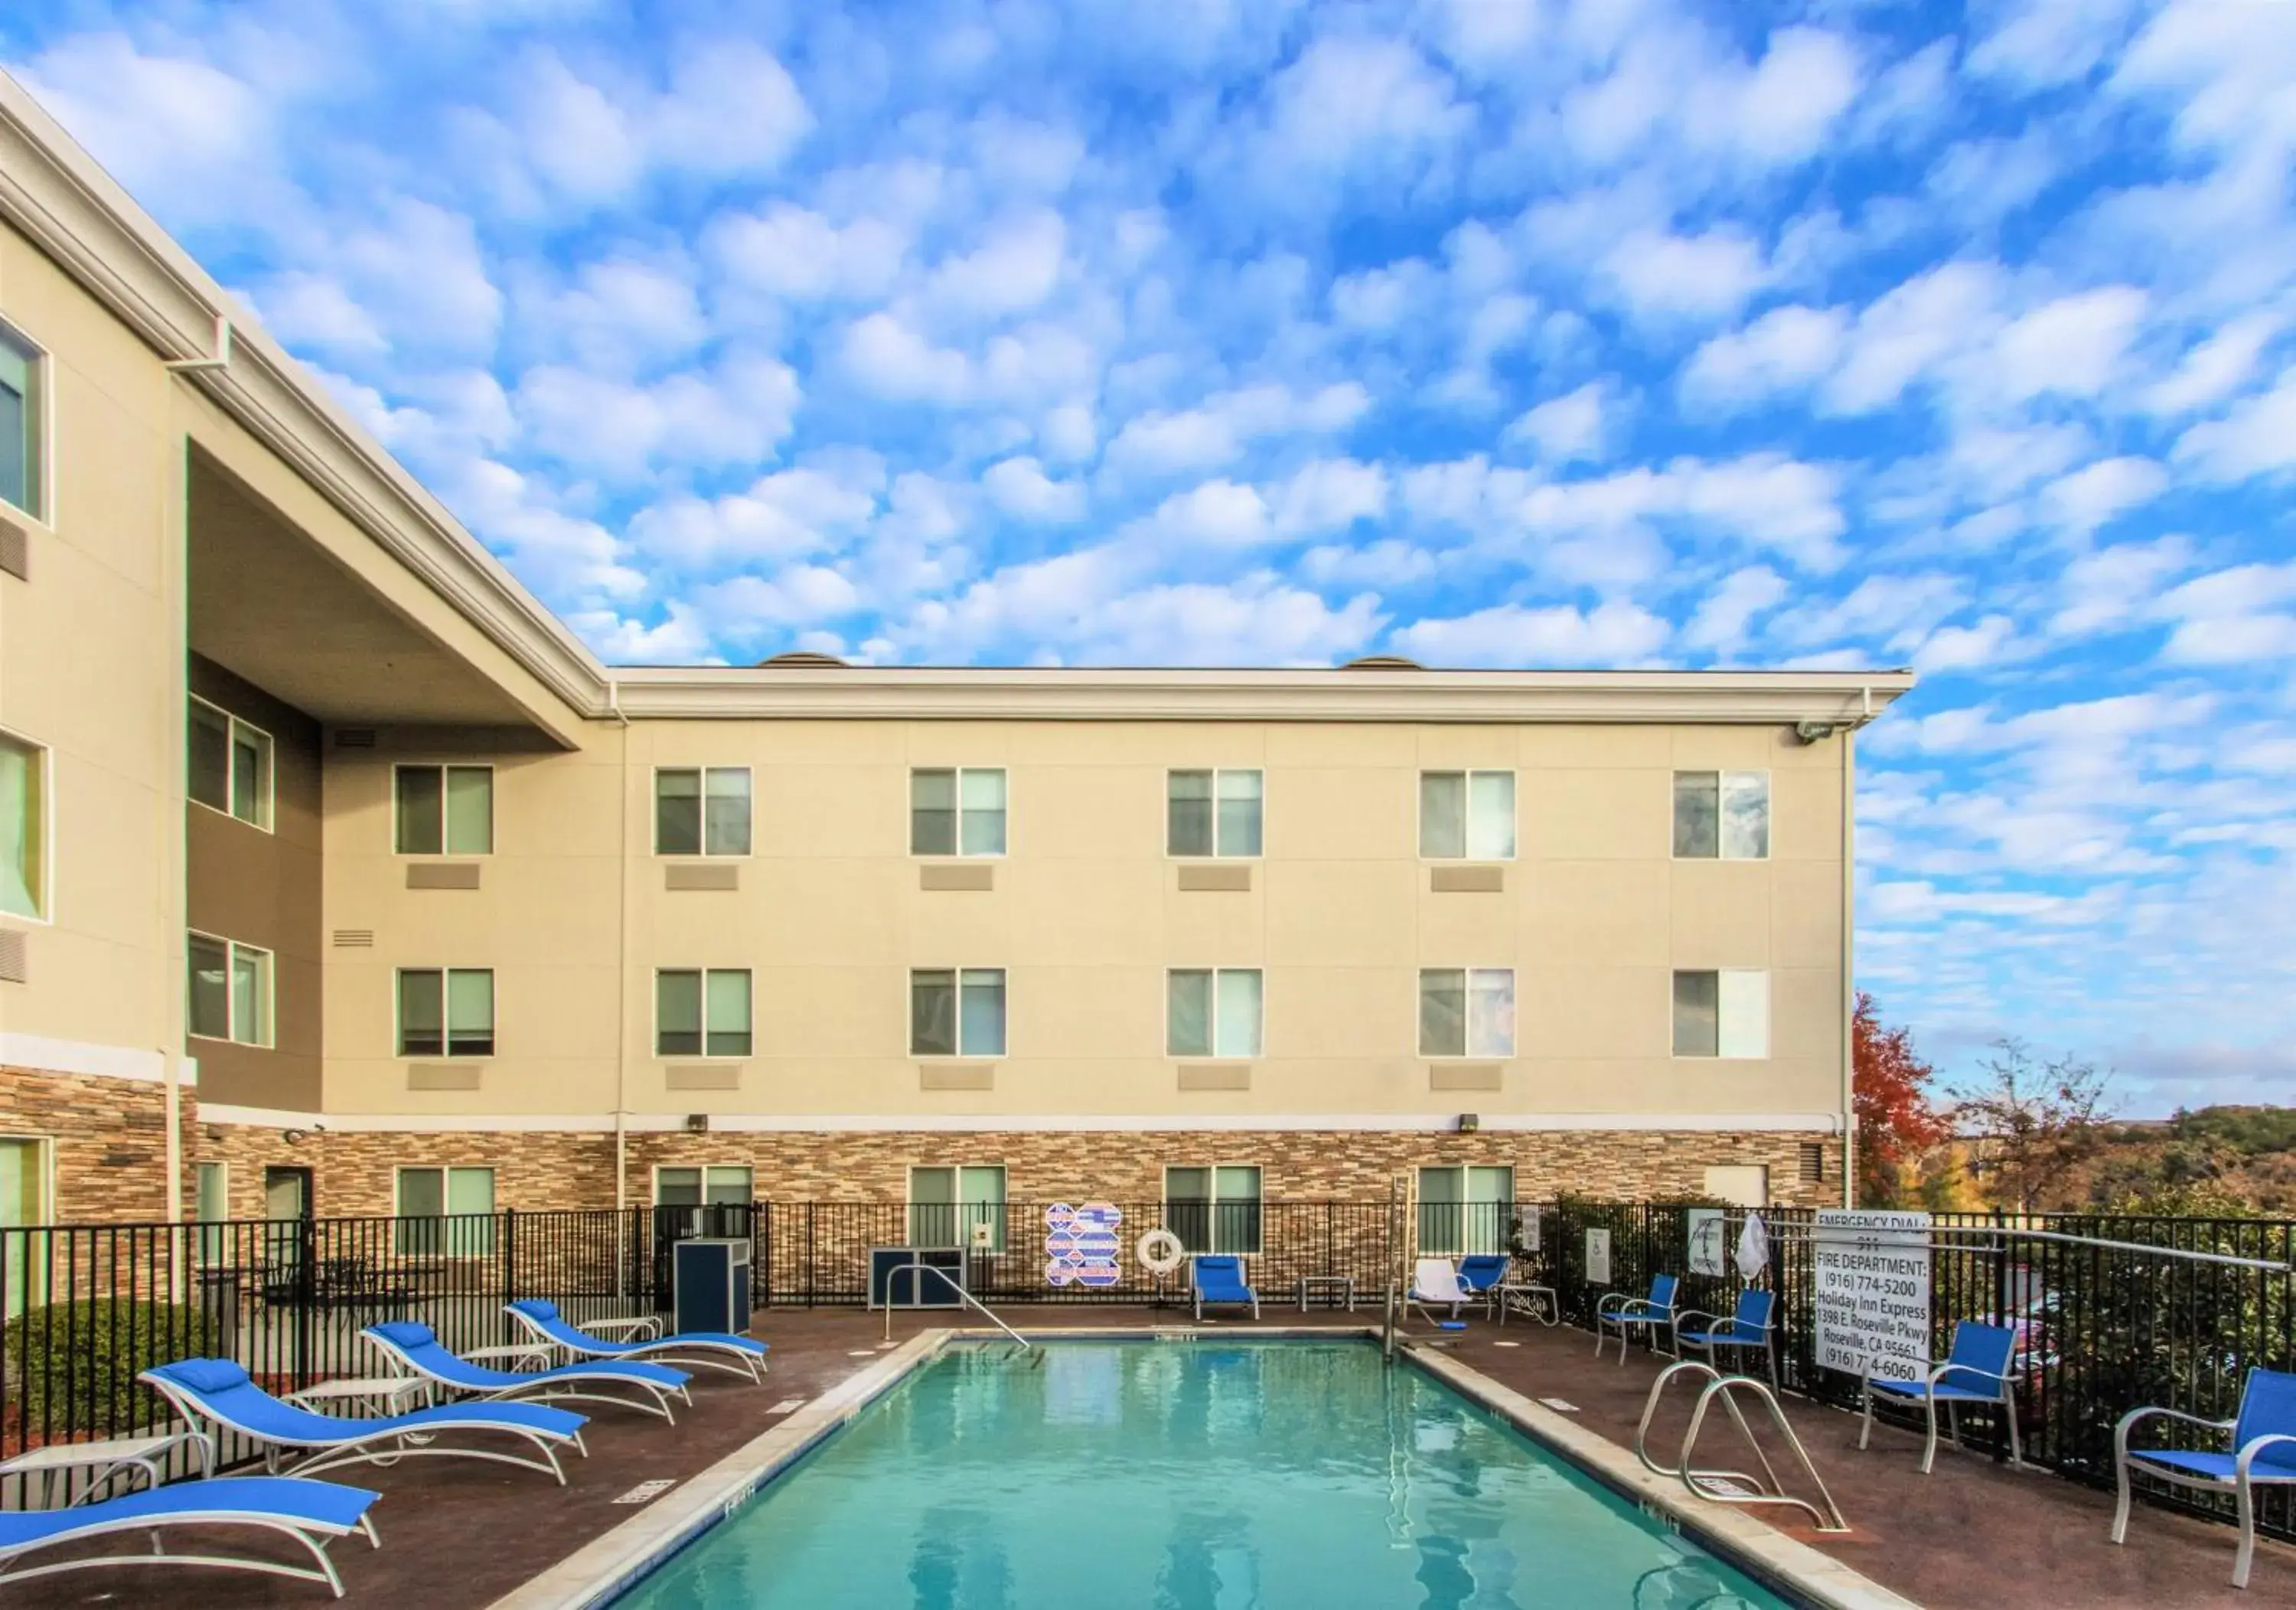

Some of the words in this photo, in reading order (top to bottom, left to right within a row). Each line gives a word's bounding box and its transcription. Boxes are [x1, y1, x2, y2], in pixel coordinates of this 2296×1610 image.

[1818, 1214, 1888, 1229] EMERGENCY
[1817, 1253, 1841, 1268] FIRE
[1842, 1254, 1927, 1277] DEPARTMENT:
[1825, 1273, 1854, 1291] (916)
[1857, 1276, 1917, 1298] 774-5200
[1818, 1289, 1857, 1312] Holiday
[1859, 1295, 1877, 1312] Inn
[1880, 1298, 1927, 1321] Express
[1818, 1309, 1839, 1325] 1398
[1851, 1314, 1896, 1336] Roseville
[1897, 1322, 1928, 1346] Pkwy
[1824, 1328, 1867, 1352] Roseville,
[1868, 1336, 1883, 1352] CA
[1885, 1340, 1917, 1359] 95661
[1825, 1346, 1854, 1368] (916)
[1856, 1354, 1916, 1381] 74-6060
